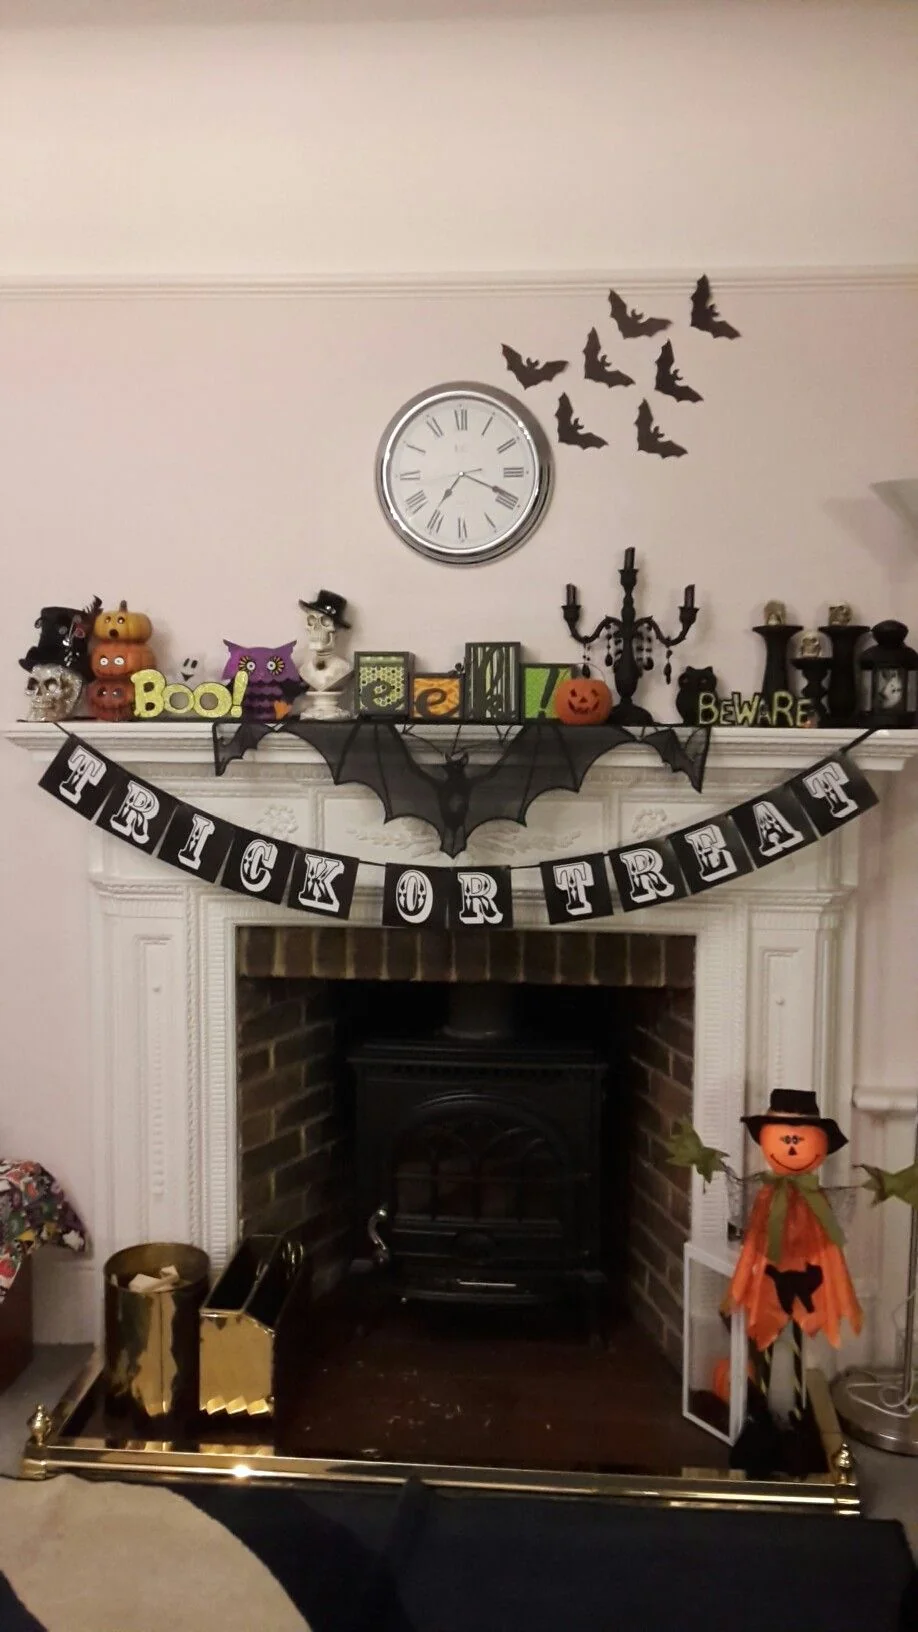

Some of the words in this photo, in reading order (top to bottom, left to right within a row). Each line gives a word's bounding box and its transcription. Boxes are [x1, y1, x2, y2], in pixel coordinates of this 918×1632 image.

[59, 744, 345, 913] TRICK
[395, 868, 504, 925] OR
[552, 760, 862, 916] TREAT
